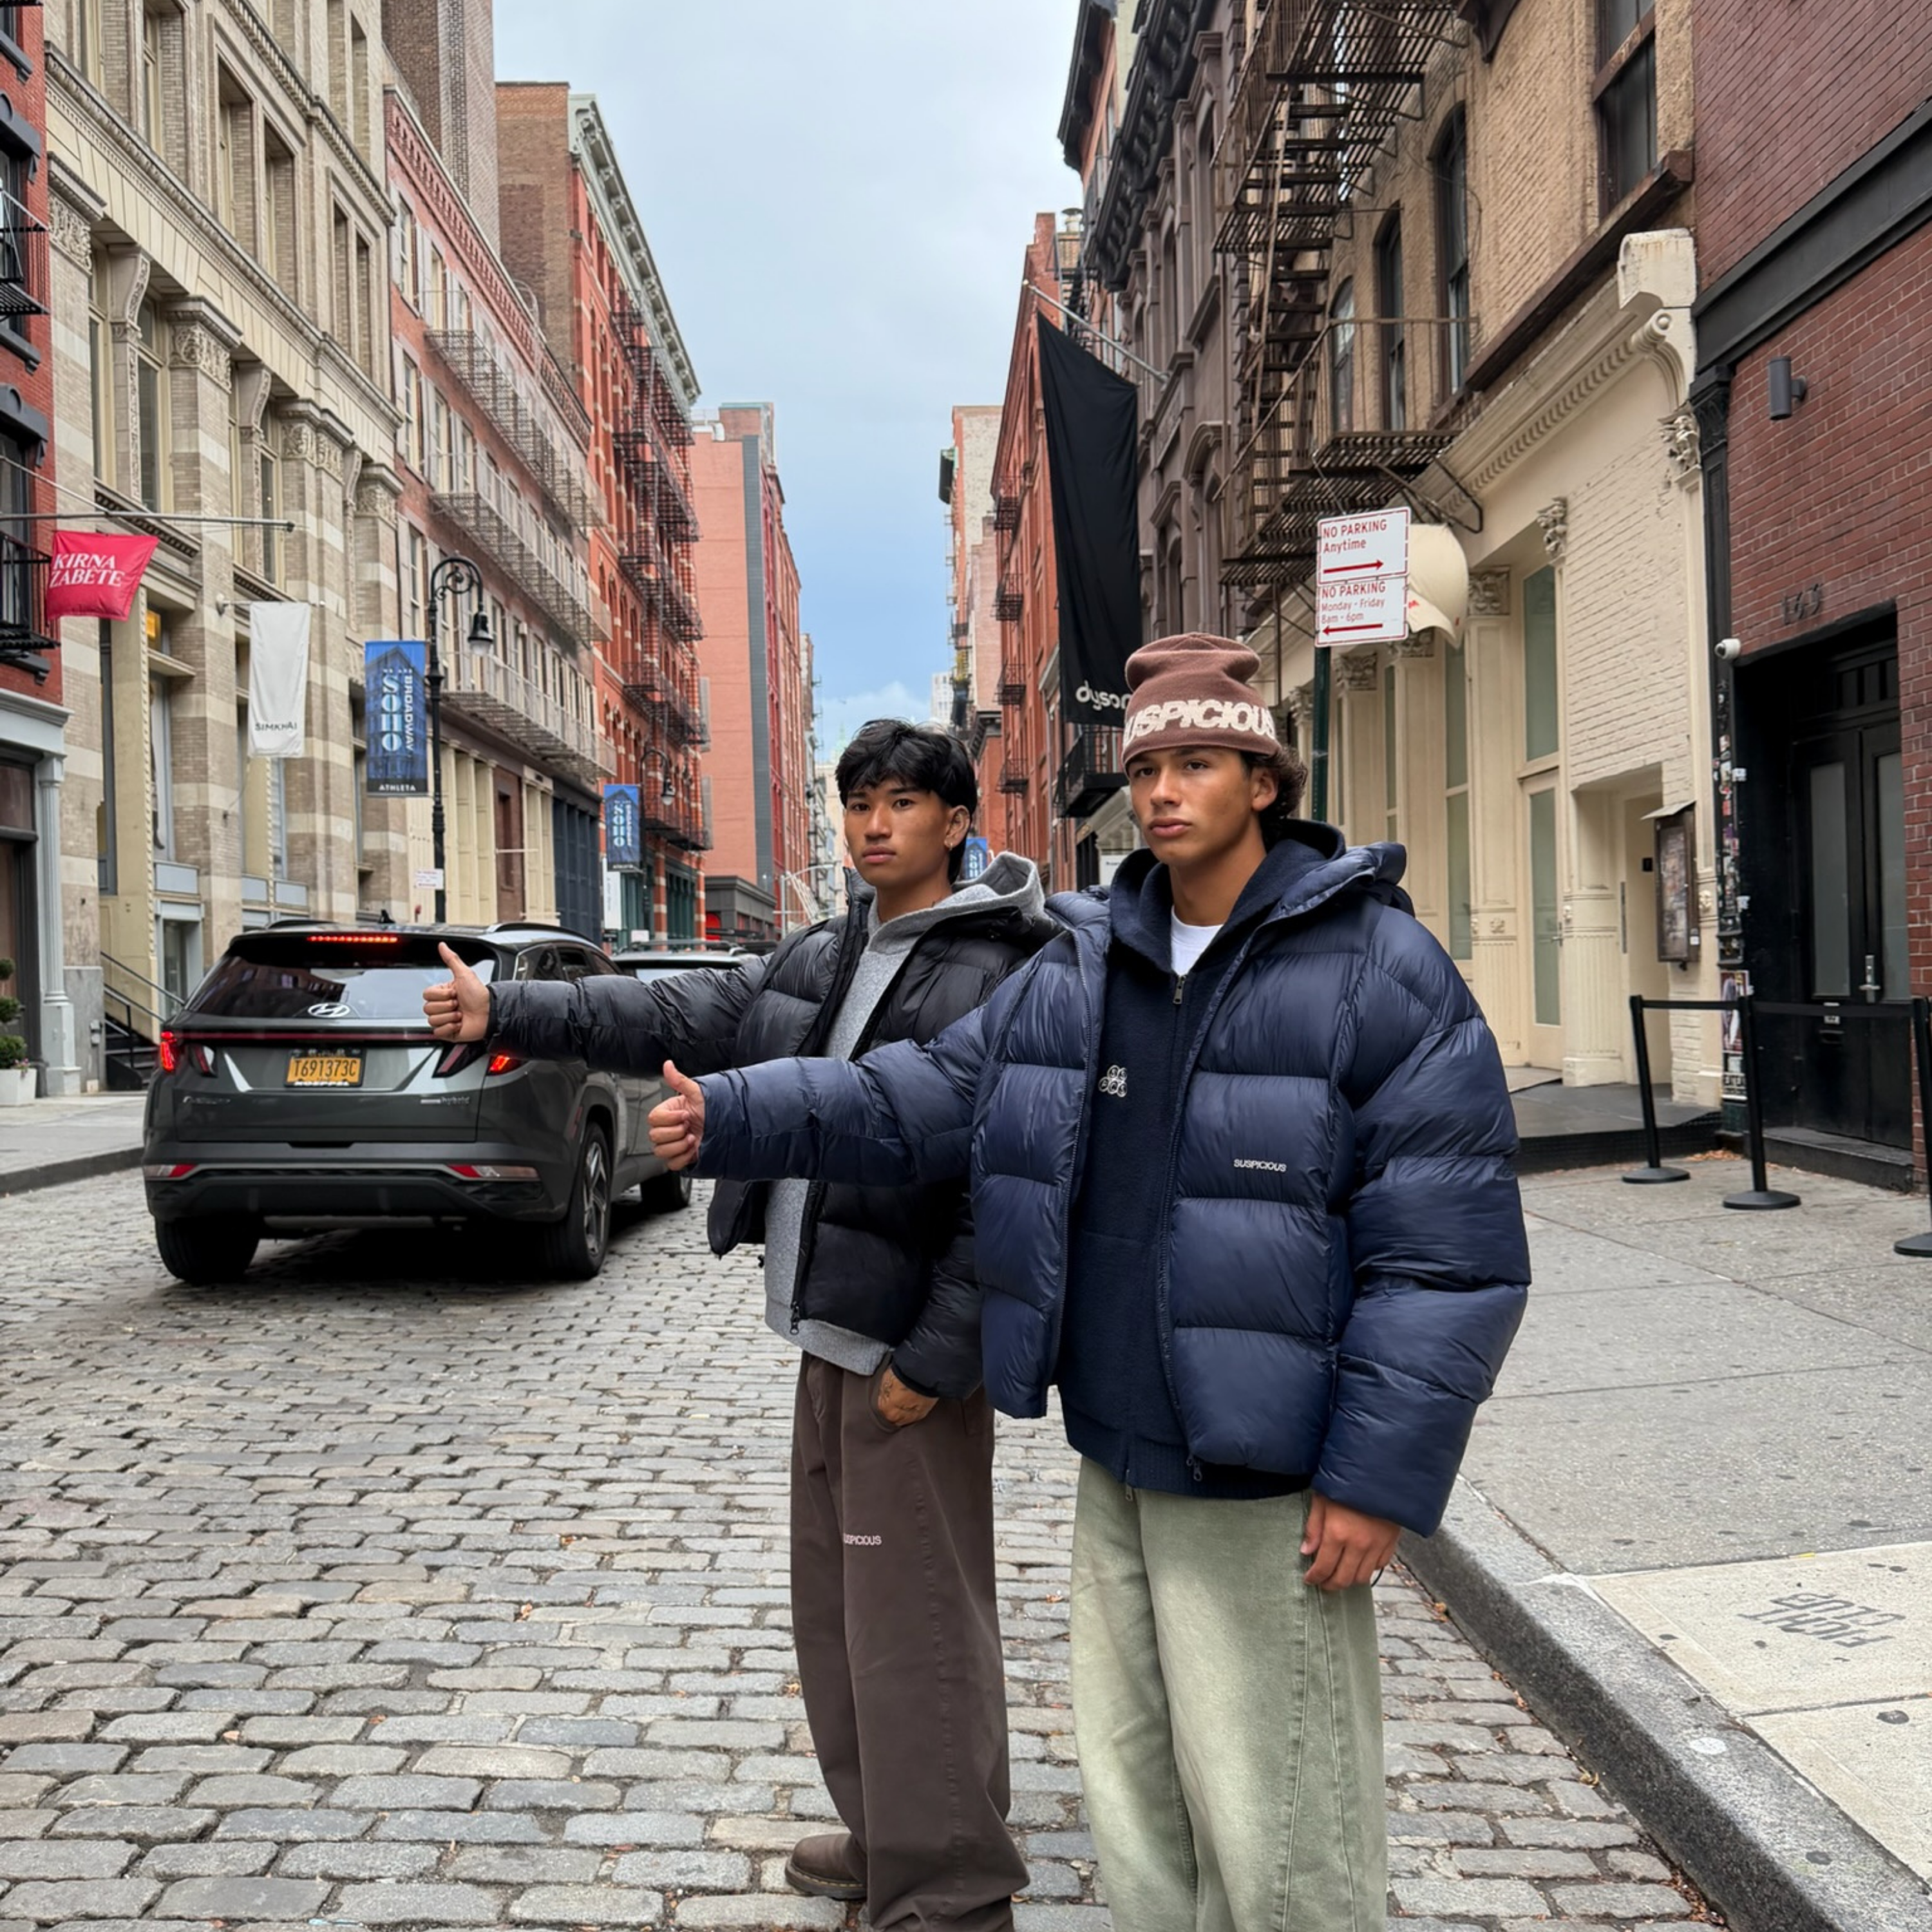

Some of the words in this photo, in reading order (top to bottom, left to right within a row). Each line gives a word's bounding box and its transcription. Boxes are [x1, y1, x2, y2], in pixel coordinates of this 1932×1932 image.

[1323, 526, 1338, 538] NO
[1340, 519, 1387, 535] PARKING
[1323, 538, 1367, 554] Anytime
[53, 553, 116, 569] KIRNA
[1321, 586, 1336, 598] NO
[1339, 582, 1386, 597] PARKING
[1321, 600, 1352, 612] Monday
[1359, 598, 1385, 609] Friday
[1321, 614, 1338, 624] 8am
[1346, 612, 1364, 622] 6pm
[404, 675, 414, 752] BROADWAY
[254, 721, 298, 732] SIMKHAI
[1124, 699, 1276, 748] USPICIOUS
[294, 1059, 357, 1077] T691373C
[1233, 1158, 1287, 1173] SUSPICIOUS
